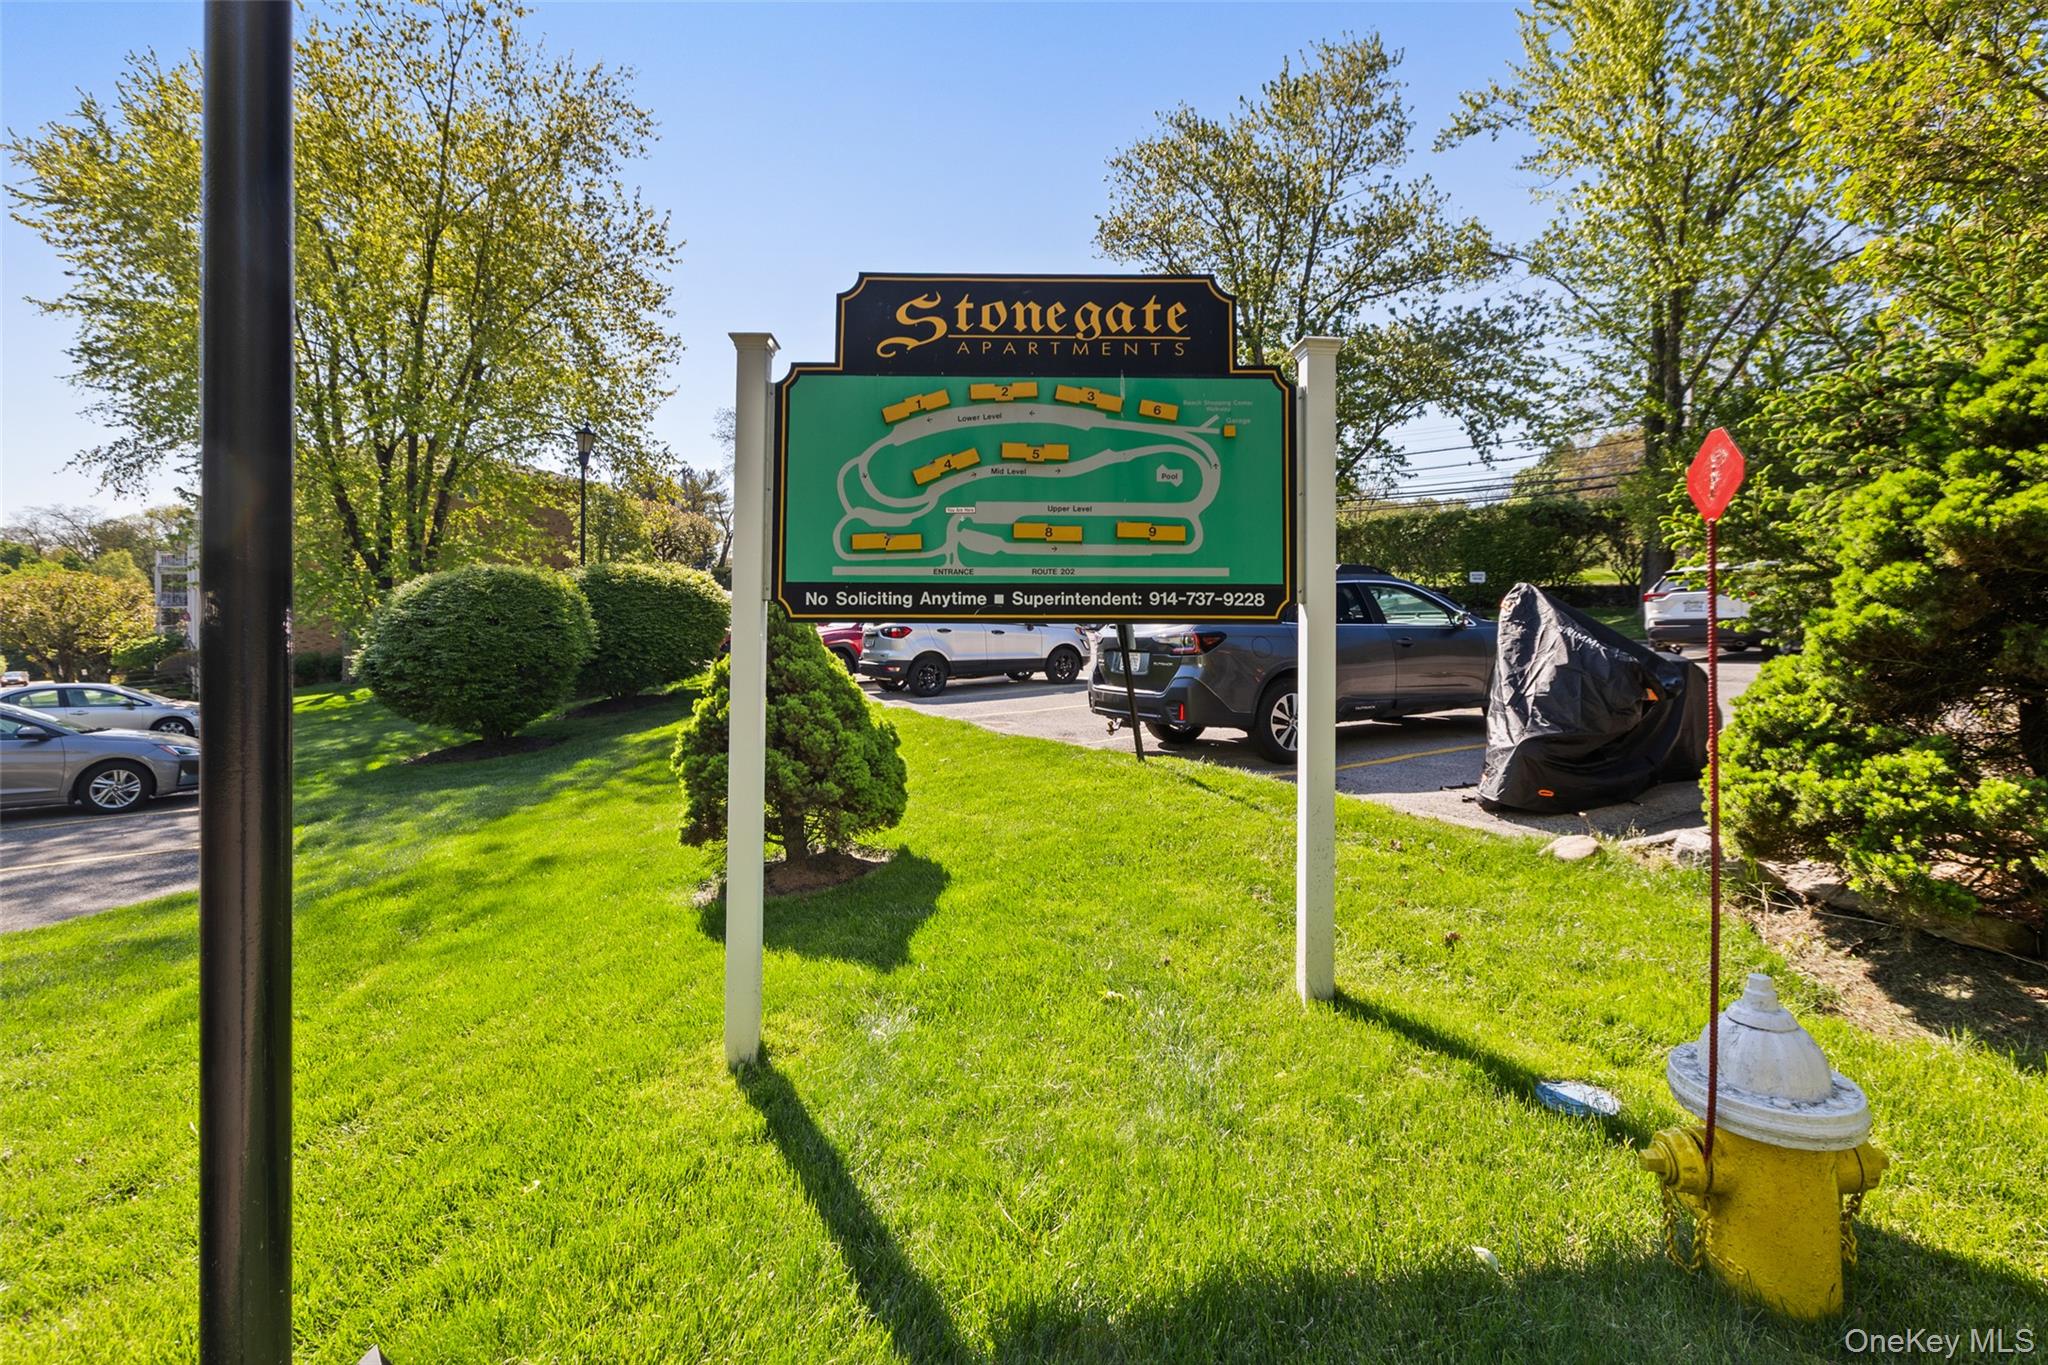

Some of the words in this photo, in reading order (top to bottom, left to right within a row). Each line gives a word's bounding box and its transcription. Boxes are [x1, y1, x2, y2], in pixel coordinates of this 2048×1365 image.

[876, 291, 1189, 358] Stonegate
[957, 341, 1185, 356] APARTMENTS
[1001, 386, 1009, 397] 2
[1087, 391, 1095, 401] 3
[915, 400, 921, 409] 1
[1153, 405, 1162, 415] 6
[983, 412, 1002, 420] Level
[1032, 449, 1040, 459] 5
[943, 459, 952, 468] 4
[1161, 472, 1178, 480] Pool
[1047, 505, 1069, 513] Upper
[1044, 527, 1053, 537] 8
[1148, 526, 1157, 536] 9
[933, 568, 974, 576] ENTRANCE
[805, 591, 828, 606] No
[836, 591, 913, 608] Soliciting
[919, 592, 987, 608] Anytime
[1012, 591, 1142, 607] Superintendent:
[1149, 592, 1265, 606] 914-737-9228
